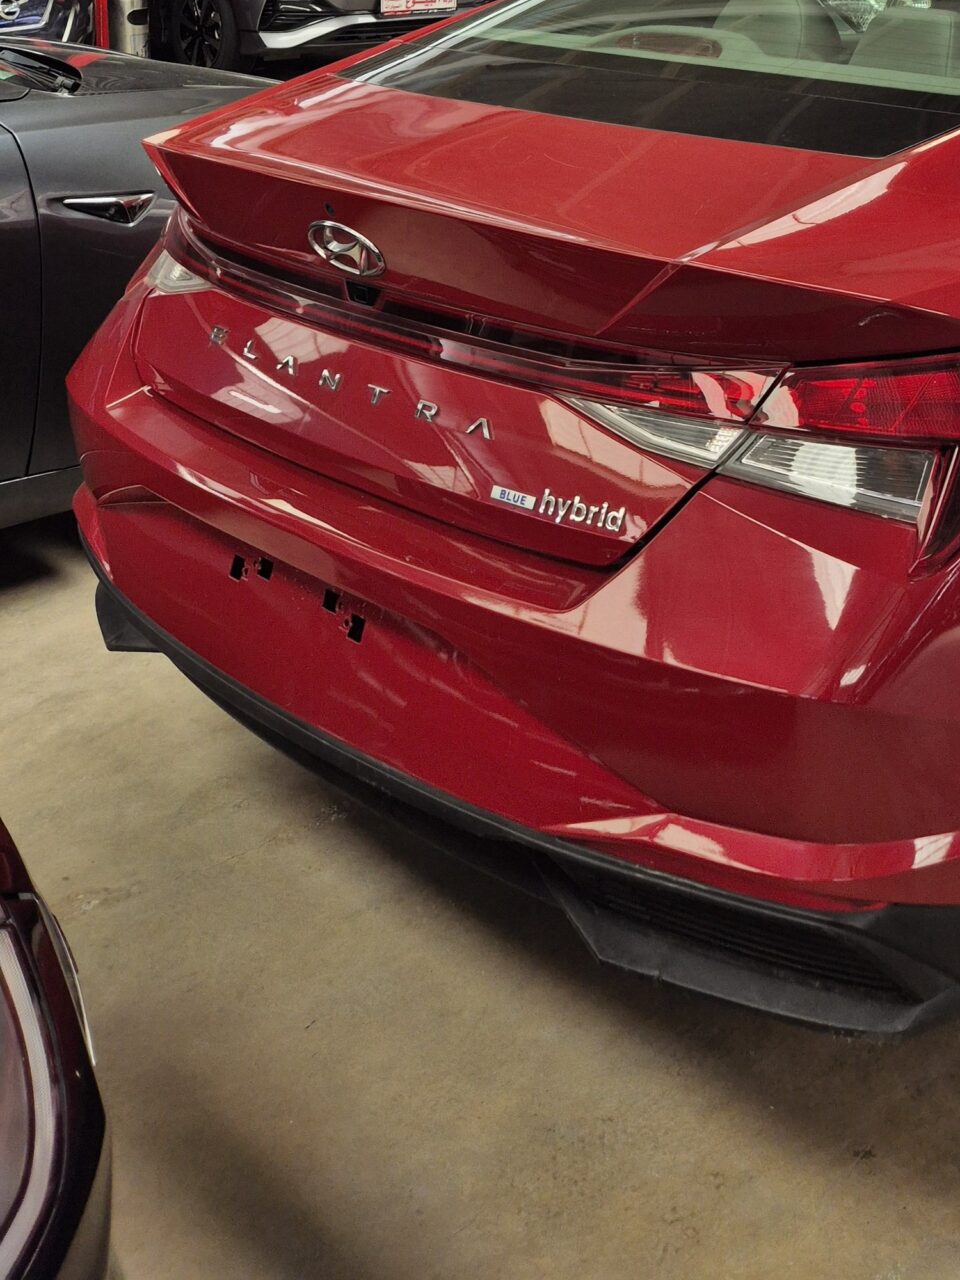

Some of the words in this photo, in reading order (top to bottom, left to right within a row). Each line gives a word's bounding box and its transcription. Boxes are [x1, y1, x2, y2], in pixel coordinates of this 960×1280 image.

[208, 324, 495, 440] ELANTRA
[499, 489, 528, 506] BLUE
[538, 488, 626, 532] hybrid
